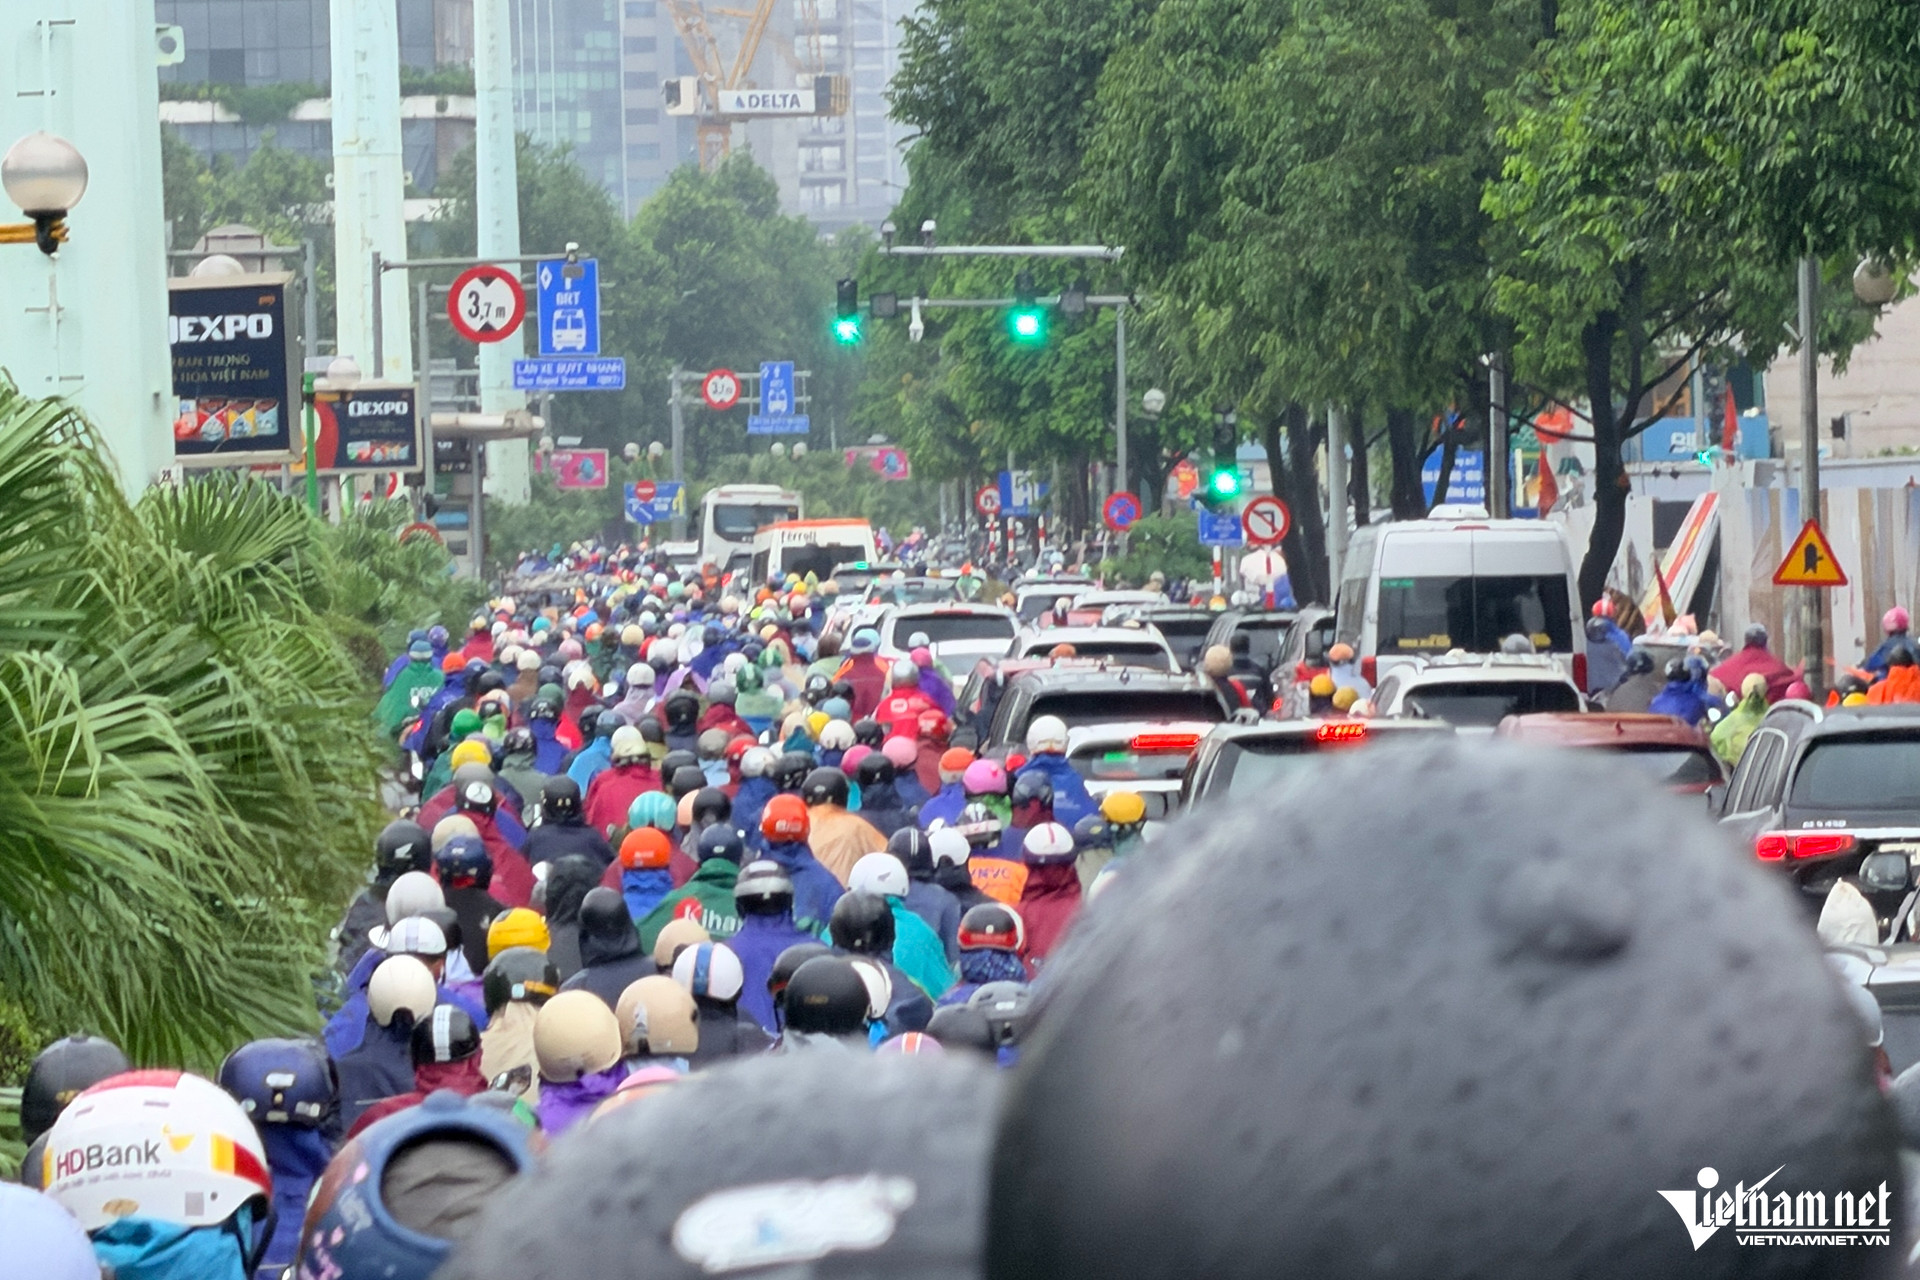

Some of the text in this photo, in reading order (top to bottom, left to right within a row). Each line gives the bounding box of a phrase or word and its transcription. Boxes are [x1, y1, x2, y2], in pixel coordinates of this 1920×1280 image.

[748, 93, 801, 109] DELTA
[556, 292, 580, 306] BRT
[57, 1139, 161, 1180] HDBank
